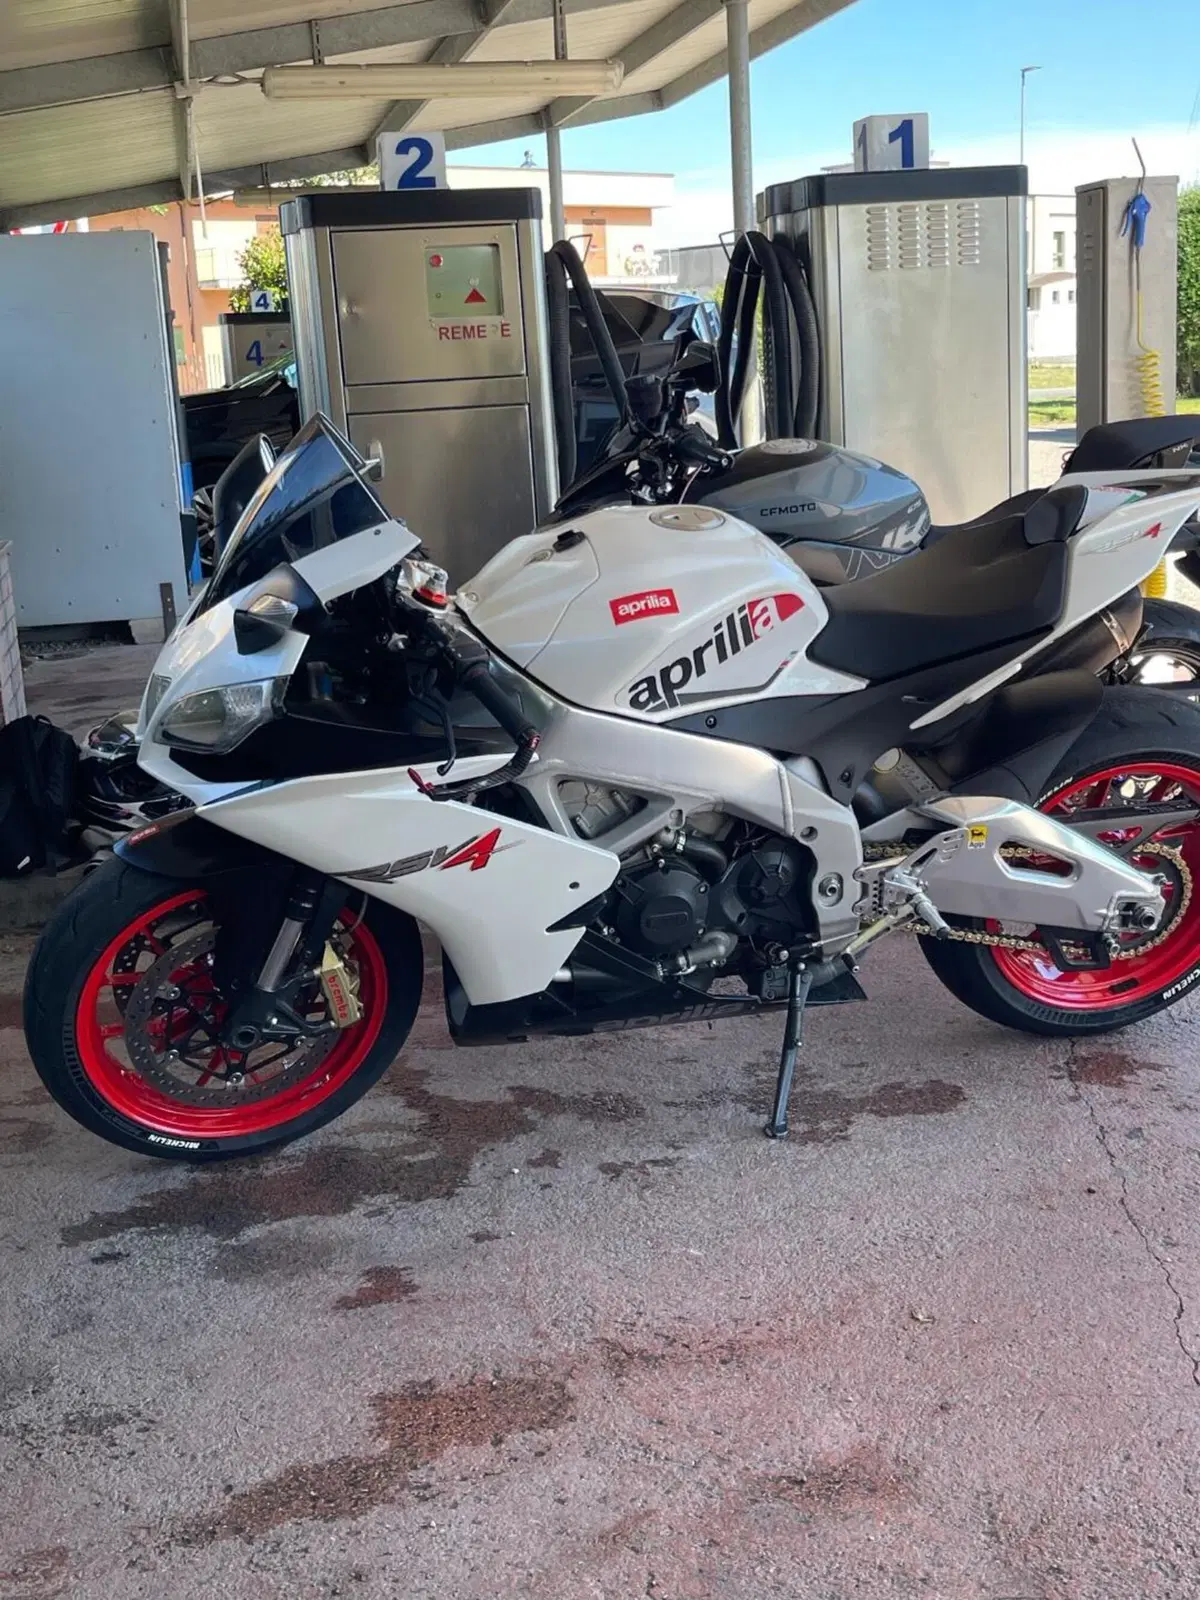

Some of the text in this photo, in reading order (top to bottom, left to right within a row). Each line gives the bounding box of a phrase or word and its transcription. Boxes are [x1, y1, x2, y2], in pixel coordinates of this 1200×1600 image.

[888, 119, 914, 168] 1
[395, 137, 436, 190] 2
[255, 292, 270, 310] 4
[438, 322, 512, 341] REMEE
[246, 340, 265, 367] 4
[760, 502, 817, 517] CFMOTO
[618, 594, 672, 616] aprilia
[628, 597, 778, 711] aprilia
[328, 975, 349, 1019] brembo
[147, 1134, 200, 1149] MICHELIN
